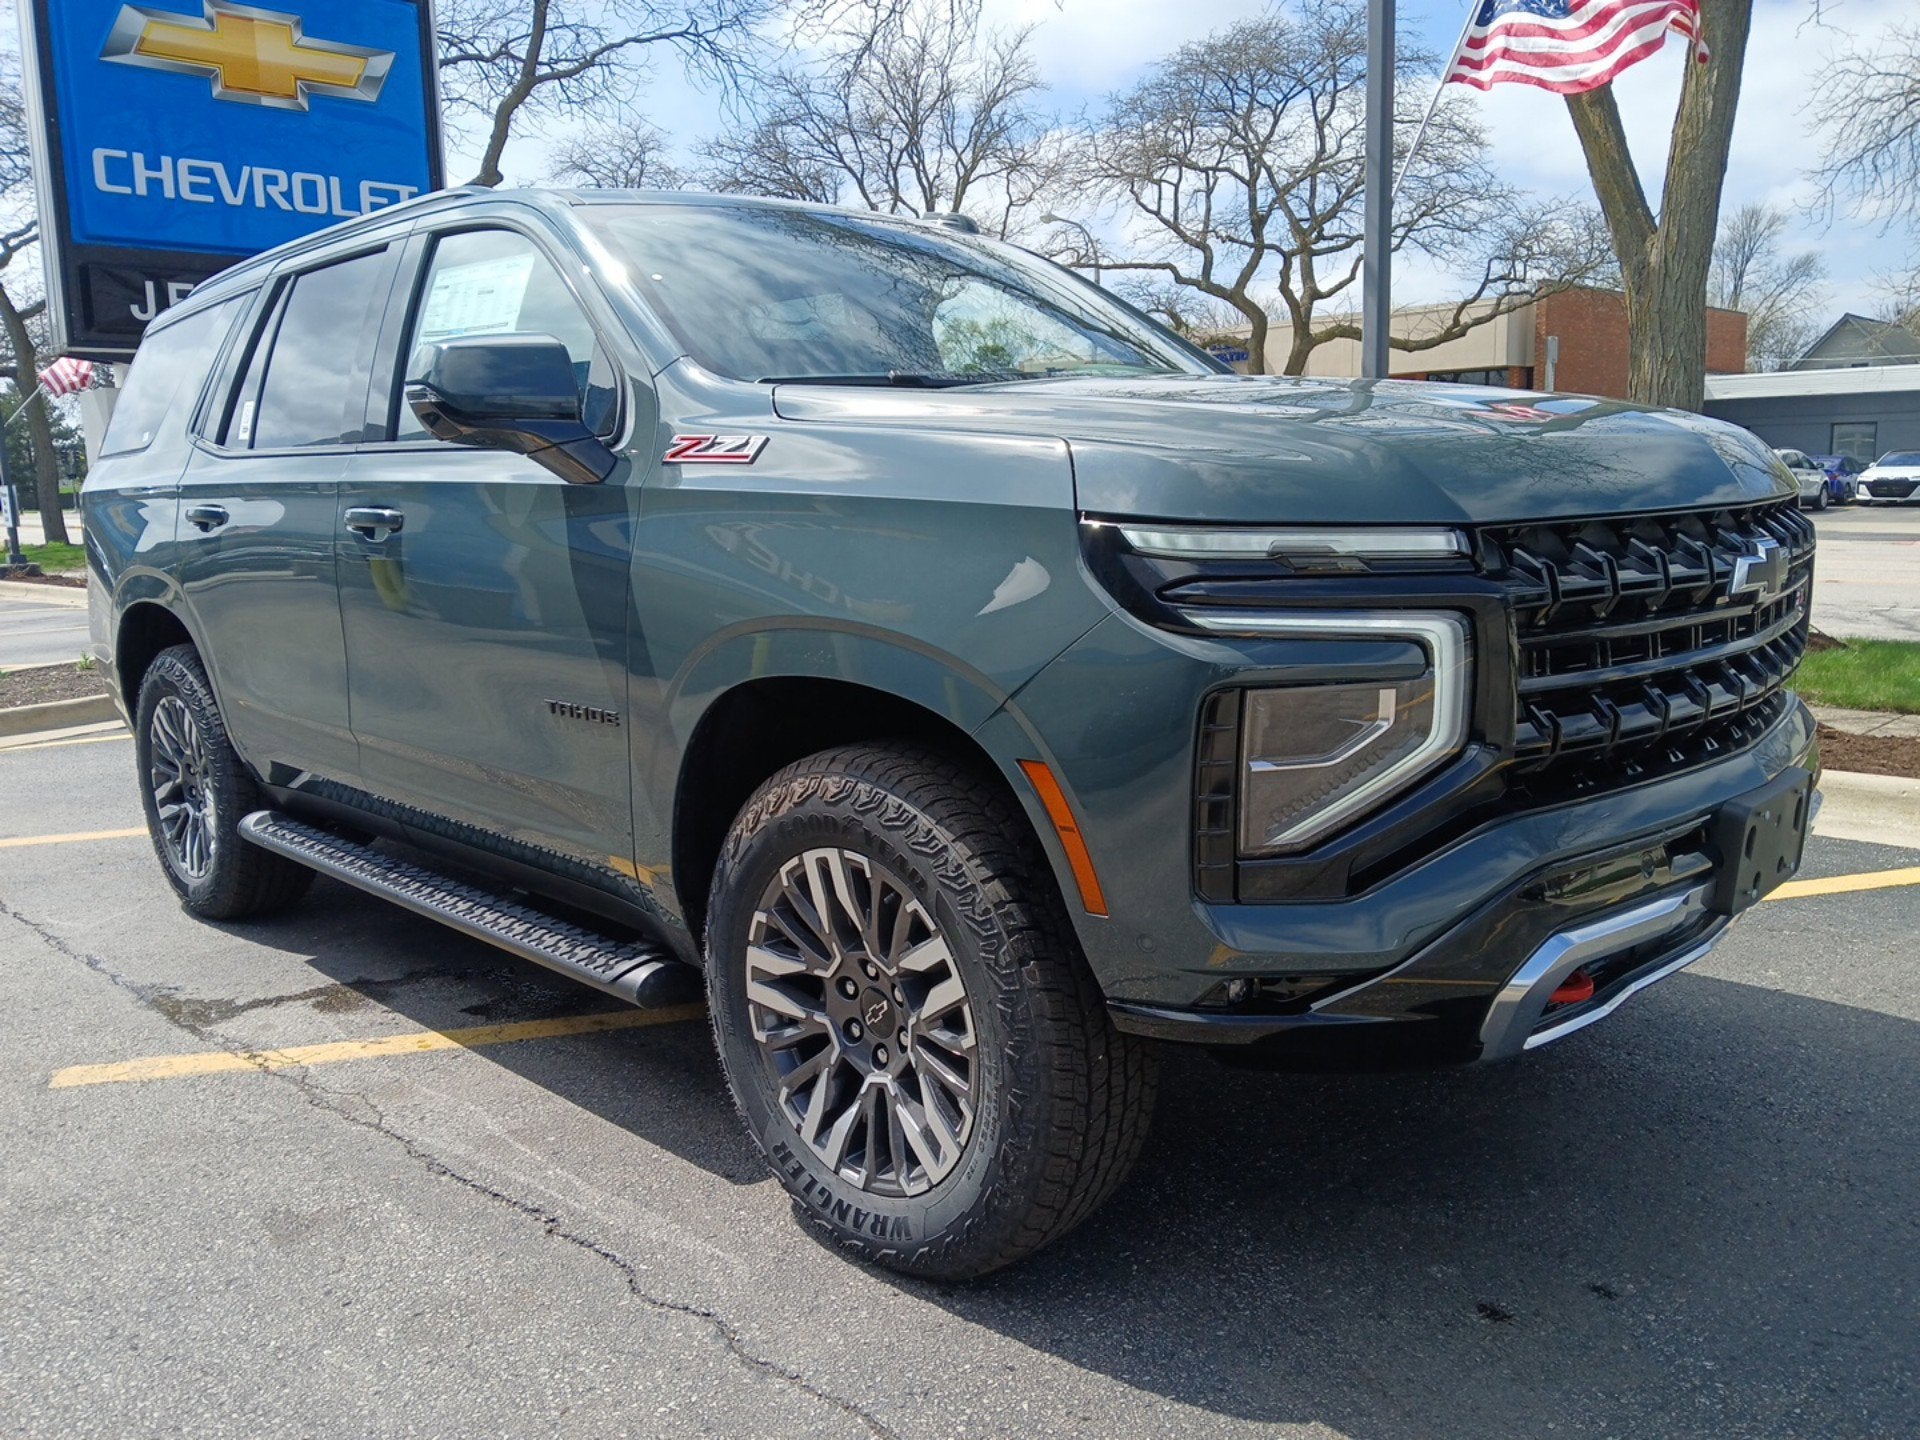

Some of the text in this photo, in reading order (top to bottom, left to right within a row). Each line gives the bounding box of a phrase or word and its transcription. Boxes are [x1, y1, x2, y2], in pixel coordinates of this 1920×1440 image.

[661, 434, 771, 465] Z71
[543, 698, 621, 728] TAHOE
[772, 1140, 913, 1241] WRANGLER
